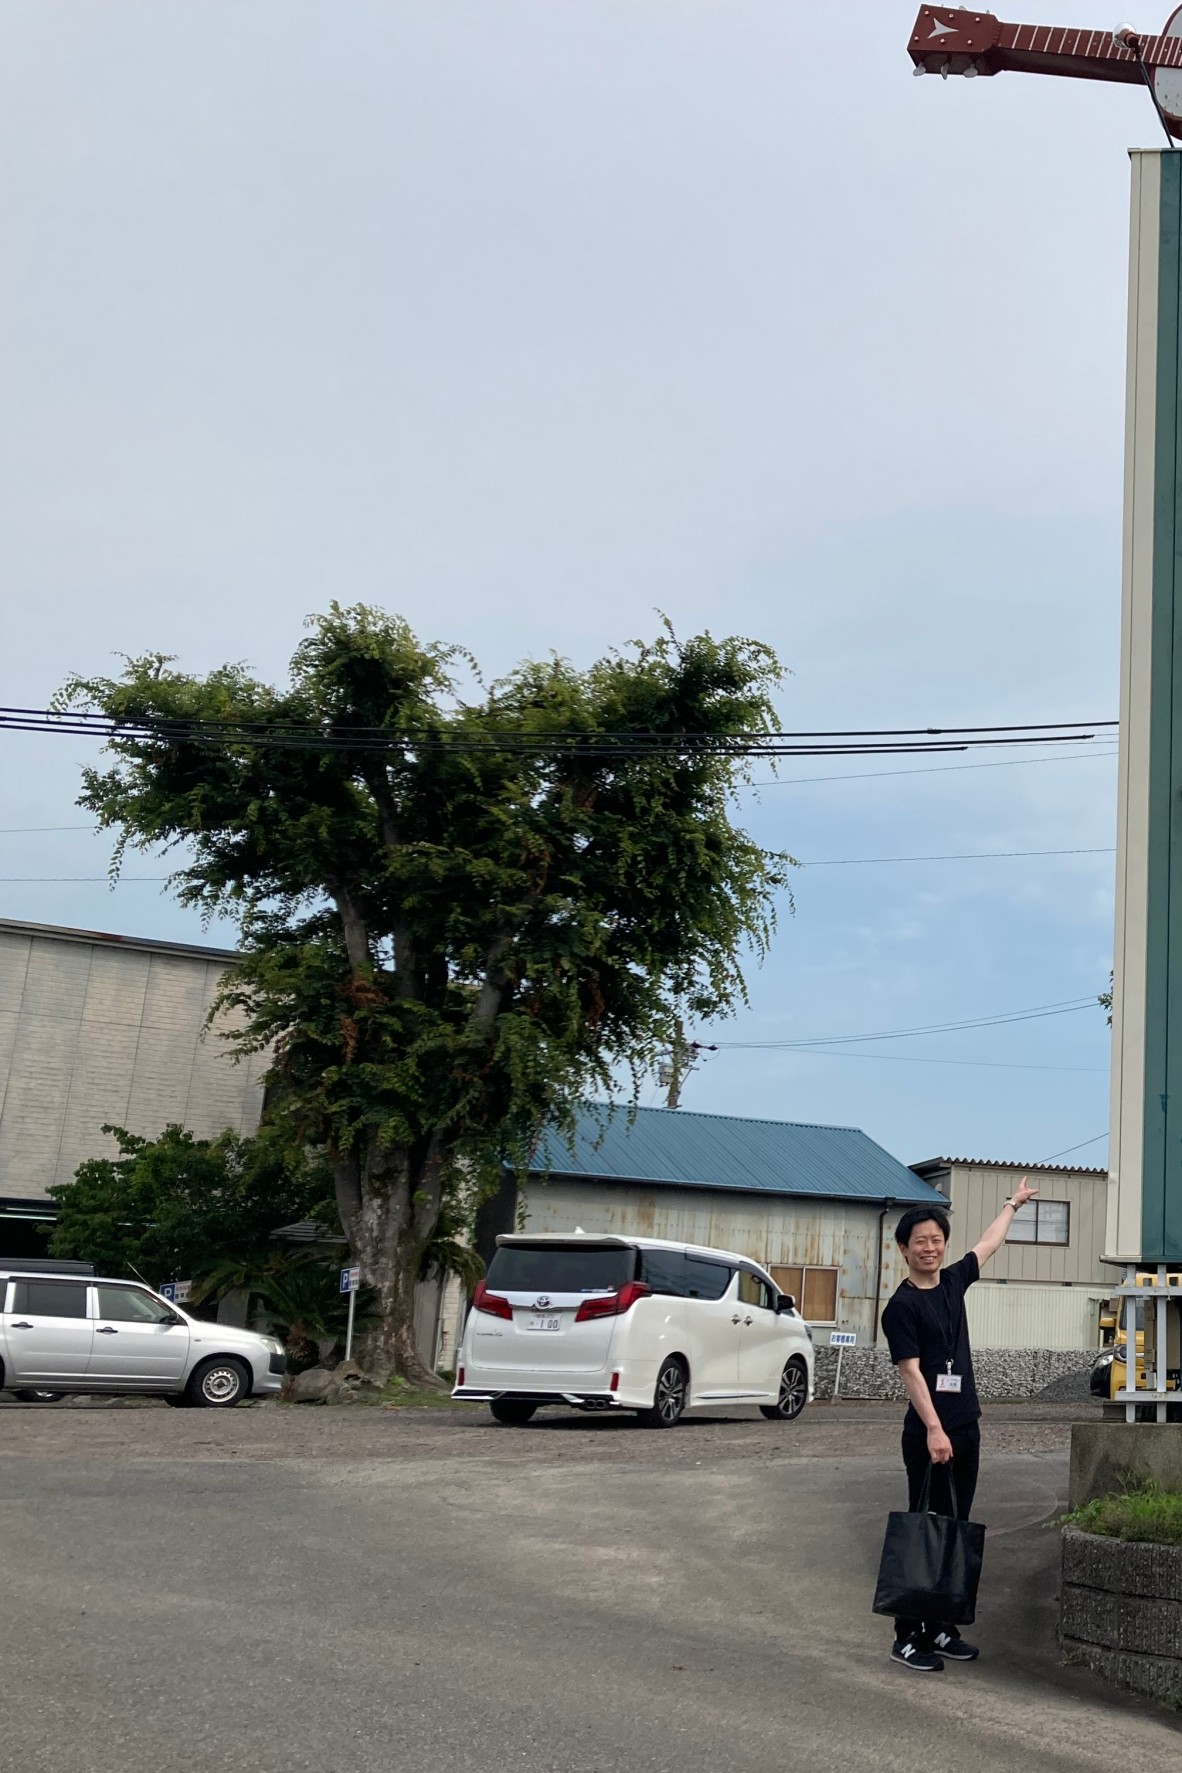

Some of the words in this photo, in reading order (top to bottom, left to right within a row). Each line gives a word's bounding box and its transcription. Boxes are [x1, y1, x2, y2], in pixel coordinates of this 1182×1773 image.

[342, 1272, 348, 1289] P
[164, 1287, 173, 1298] P
[934, 1632, 952, 1648] N
[901, 1643, 916, 1659] N
